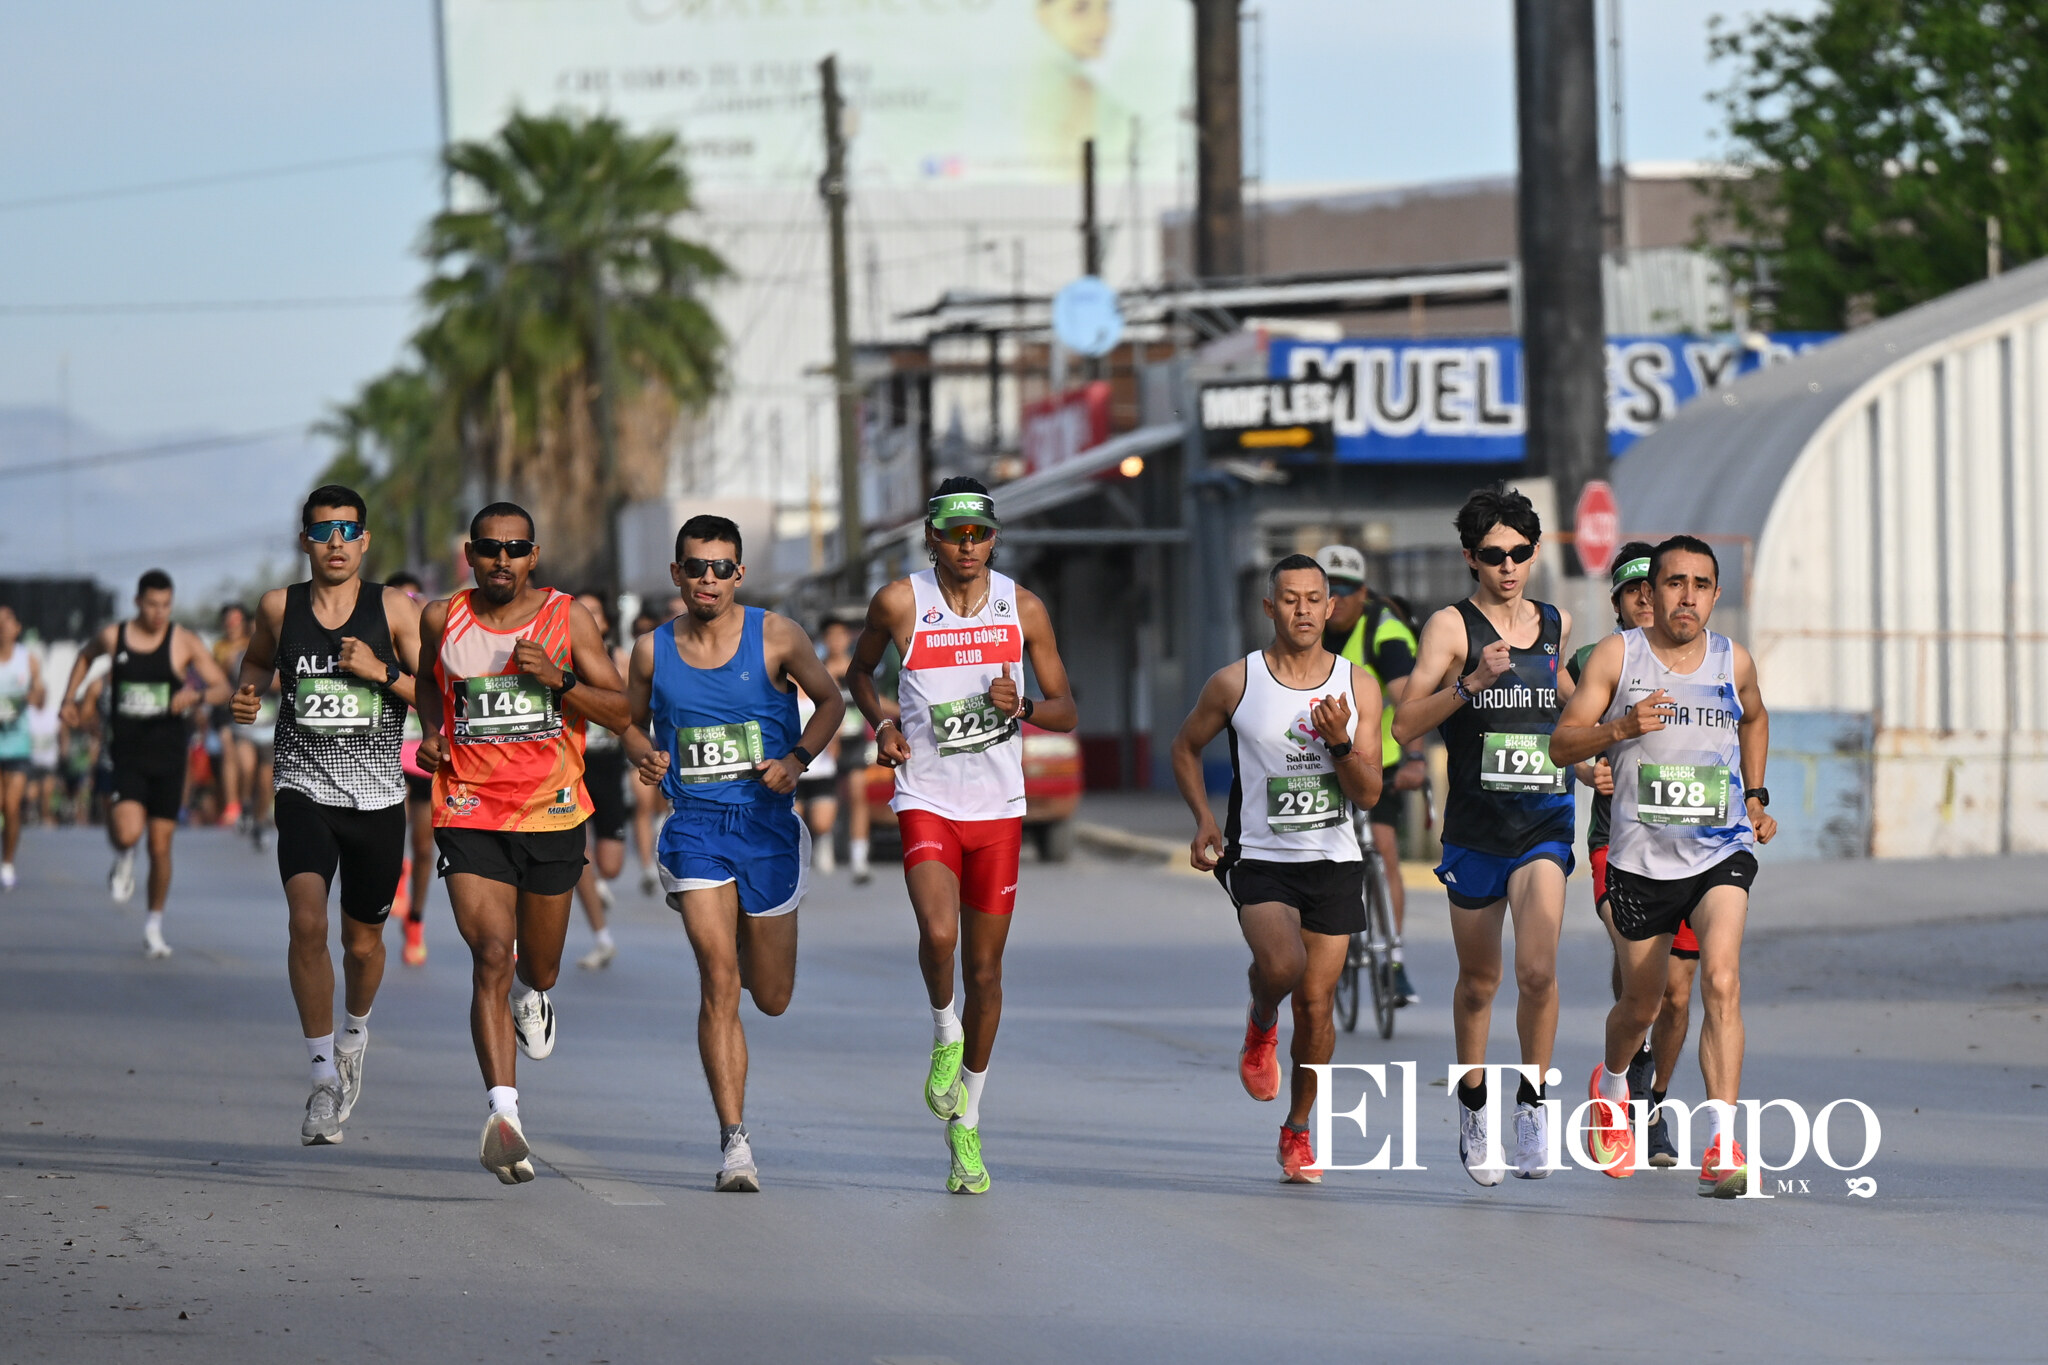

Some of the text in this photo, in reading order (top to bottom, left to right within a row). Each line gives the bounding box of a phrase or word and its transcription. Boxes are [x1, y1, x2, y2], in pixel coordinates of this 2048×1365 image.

[926, 631, 972, 649] RODOLFO
[955, 650, 983, 665] CLUB
[304, 694, 359, 718] 238
[478, 690, 532, 717] 146
[944, 706, 999, 741] 225
[1696, 707, 1736, 731] TEAM
[688, 739, 740, 767] 185
[751, 733, 762, 764] EDALLA
[1286, 753, 1321, 763] Saltillo
[1287, 763, 1303, 771] nos
[1495, 749, 1545, 774] 199
[1278, 789, 1330, 815] 295
[1650, 781, 1706, 807] 198
[1718, 778, 1727, 819] MEDALLA
